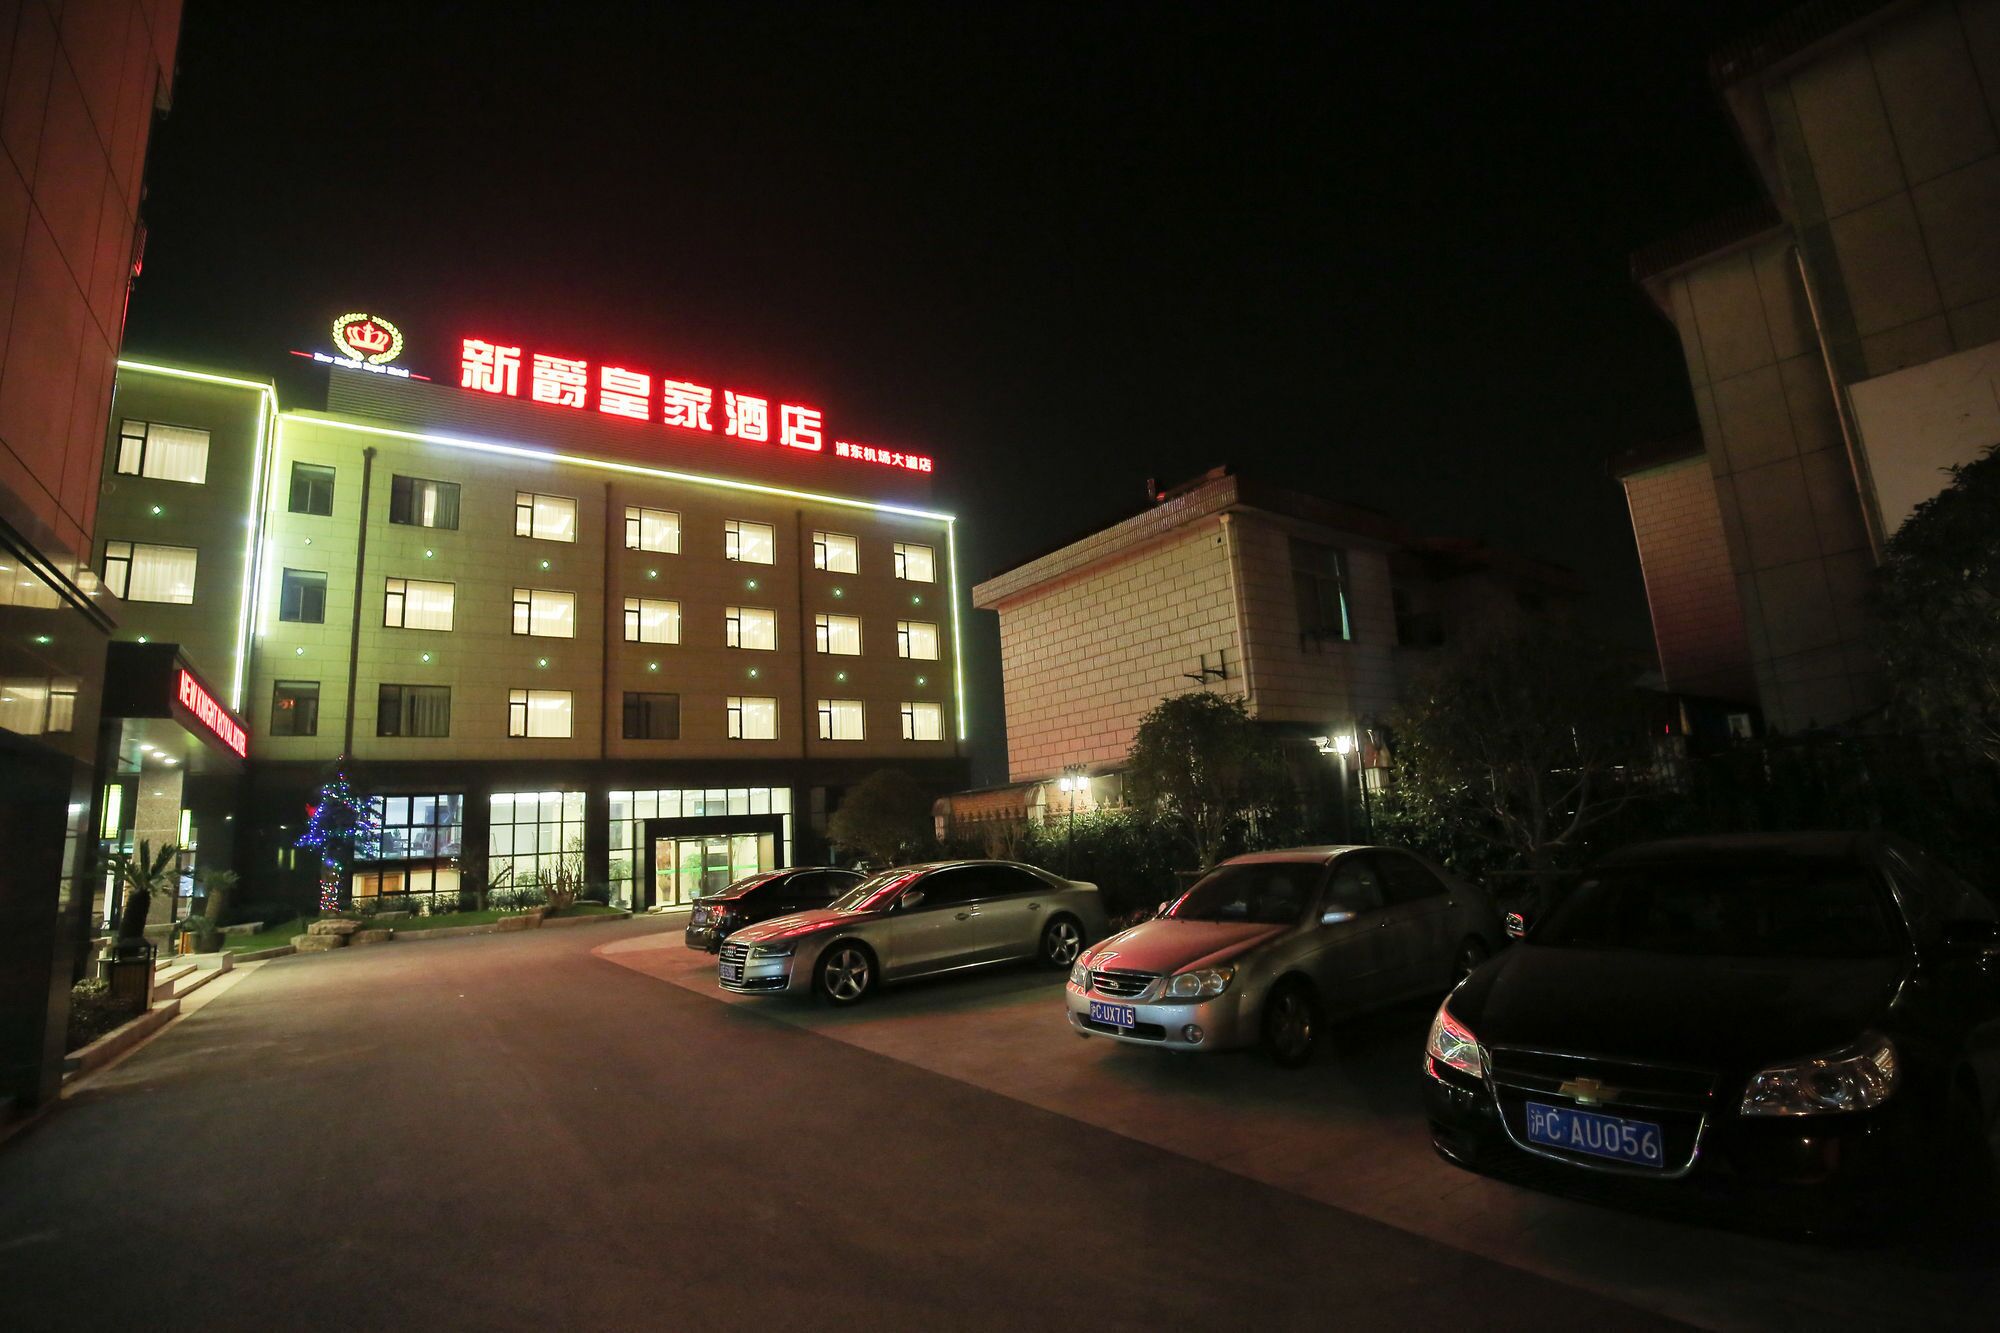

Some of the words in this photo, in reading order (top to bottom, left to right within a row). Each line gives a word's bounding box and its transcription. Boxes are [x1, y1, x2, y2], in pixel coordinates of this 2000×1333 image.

[461, 338, 822, 451] 新爵皇家酒店
[179, 669, 198, 712] NEW
